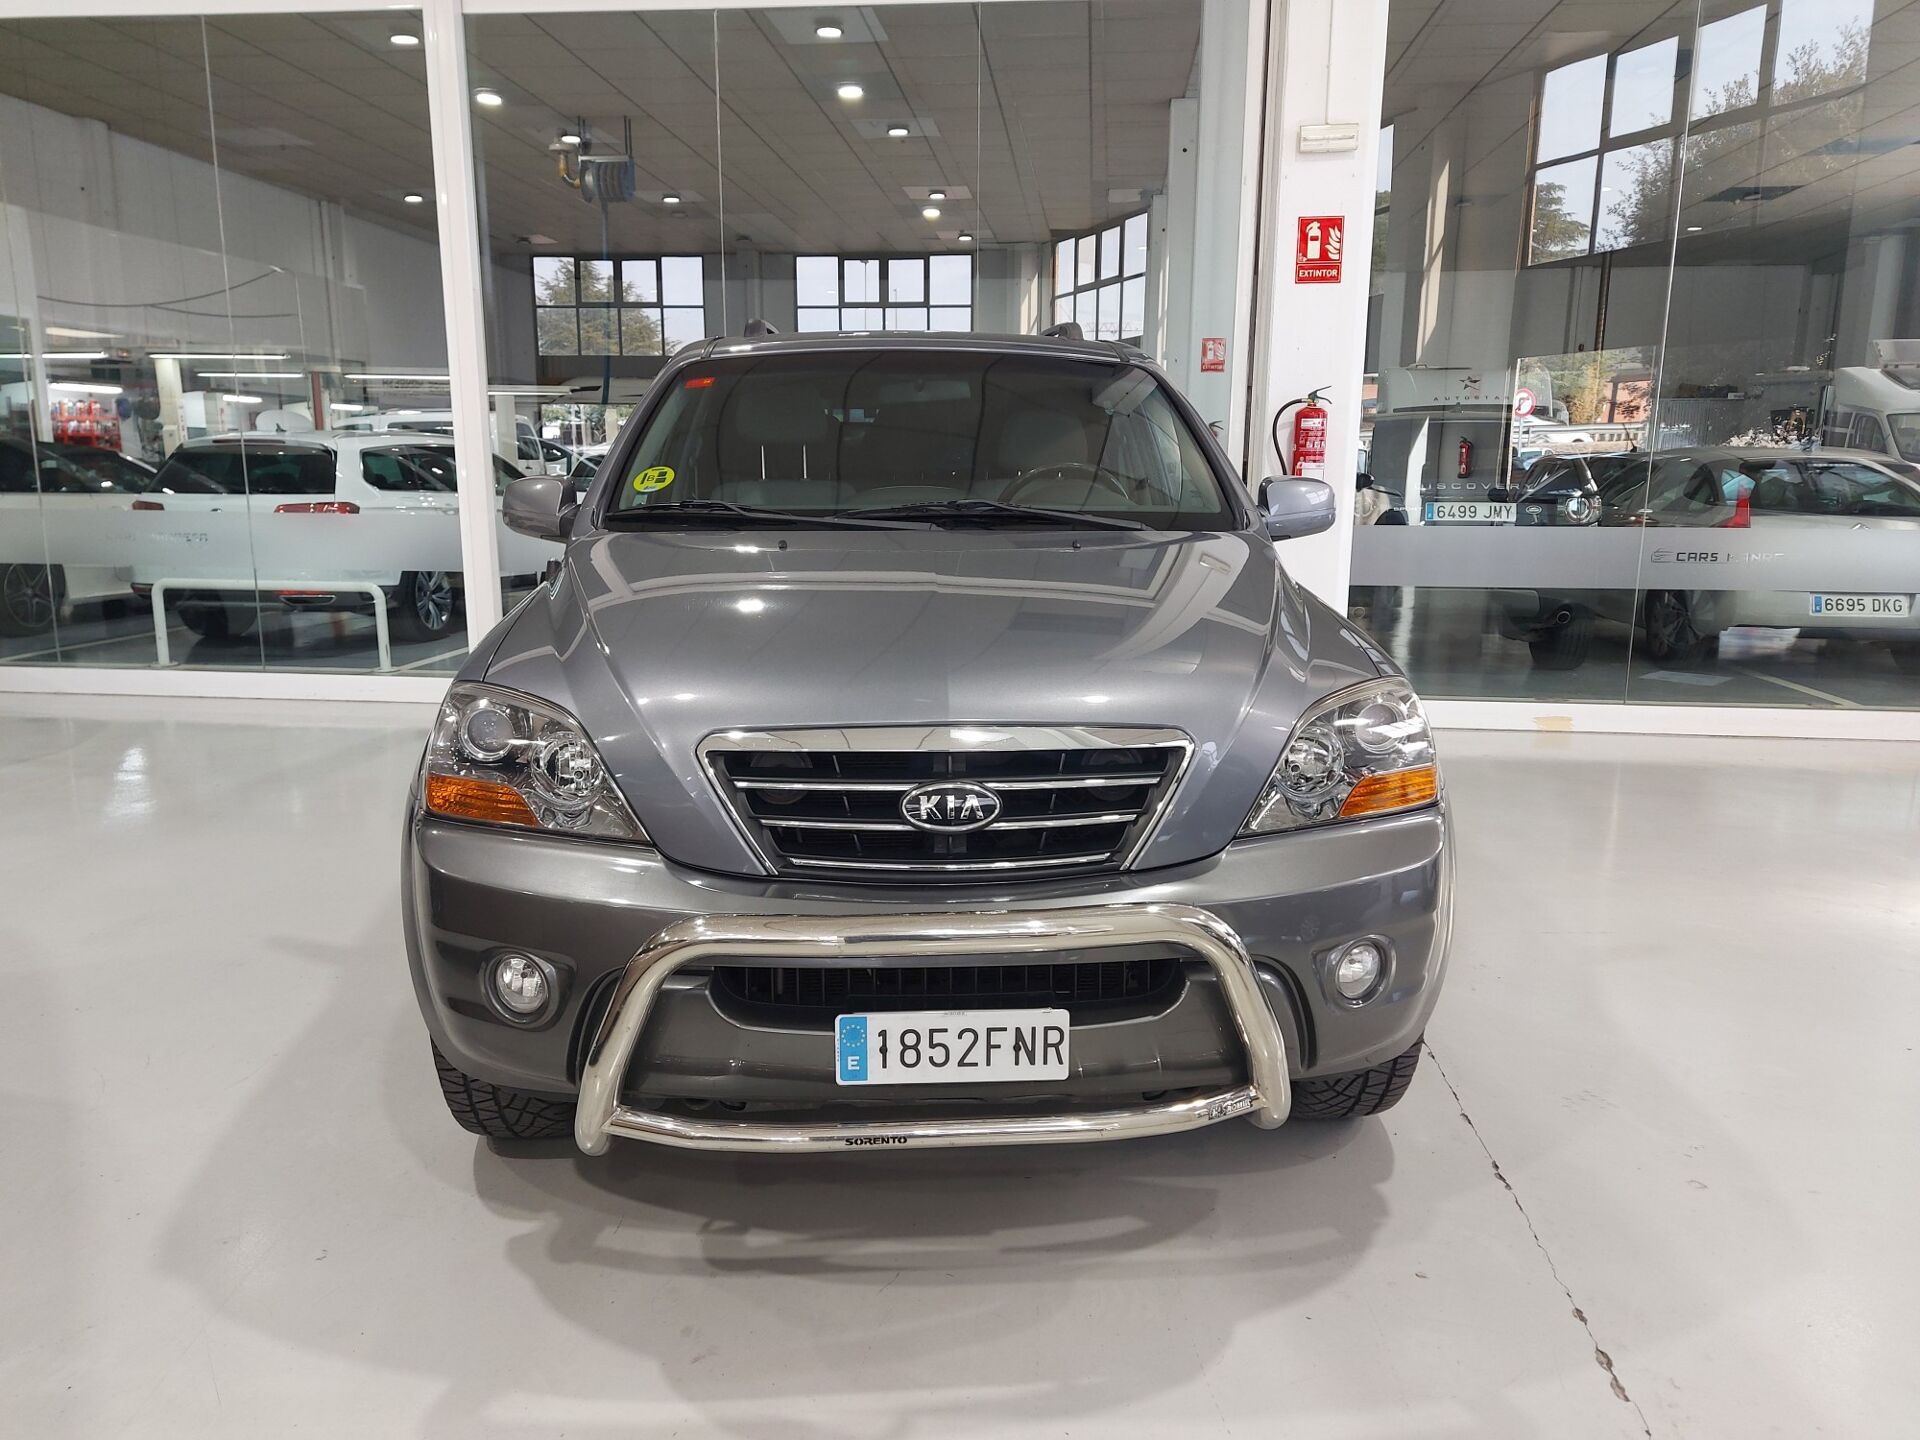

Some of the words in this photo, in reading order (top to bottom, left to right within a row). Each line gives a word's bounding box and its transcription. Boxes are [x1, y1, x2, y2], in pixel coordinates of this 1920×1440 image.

[1299, 269, 1338, 278] EXTINTOR
[1414, 482, 1535, 490] ISCOVERY
[1436, 505, 1478, 519] 6499
[1483, 505, 1513, 519] JMY
[1676, 552, 1719, 562] CARS
[1824, 598, 1866, 612] 6695
[1872, 599, 1903, 612] DKG
[918, 795, 985, 820] KIA
[847, 1055, 860, 1071] E
[878, 1026, 1065, 1069] 1852FNR
[845, 1136, 908, 1146] SORENTO
